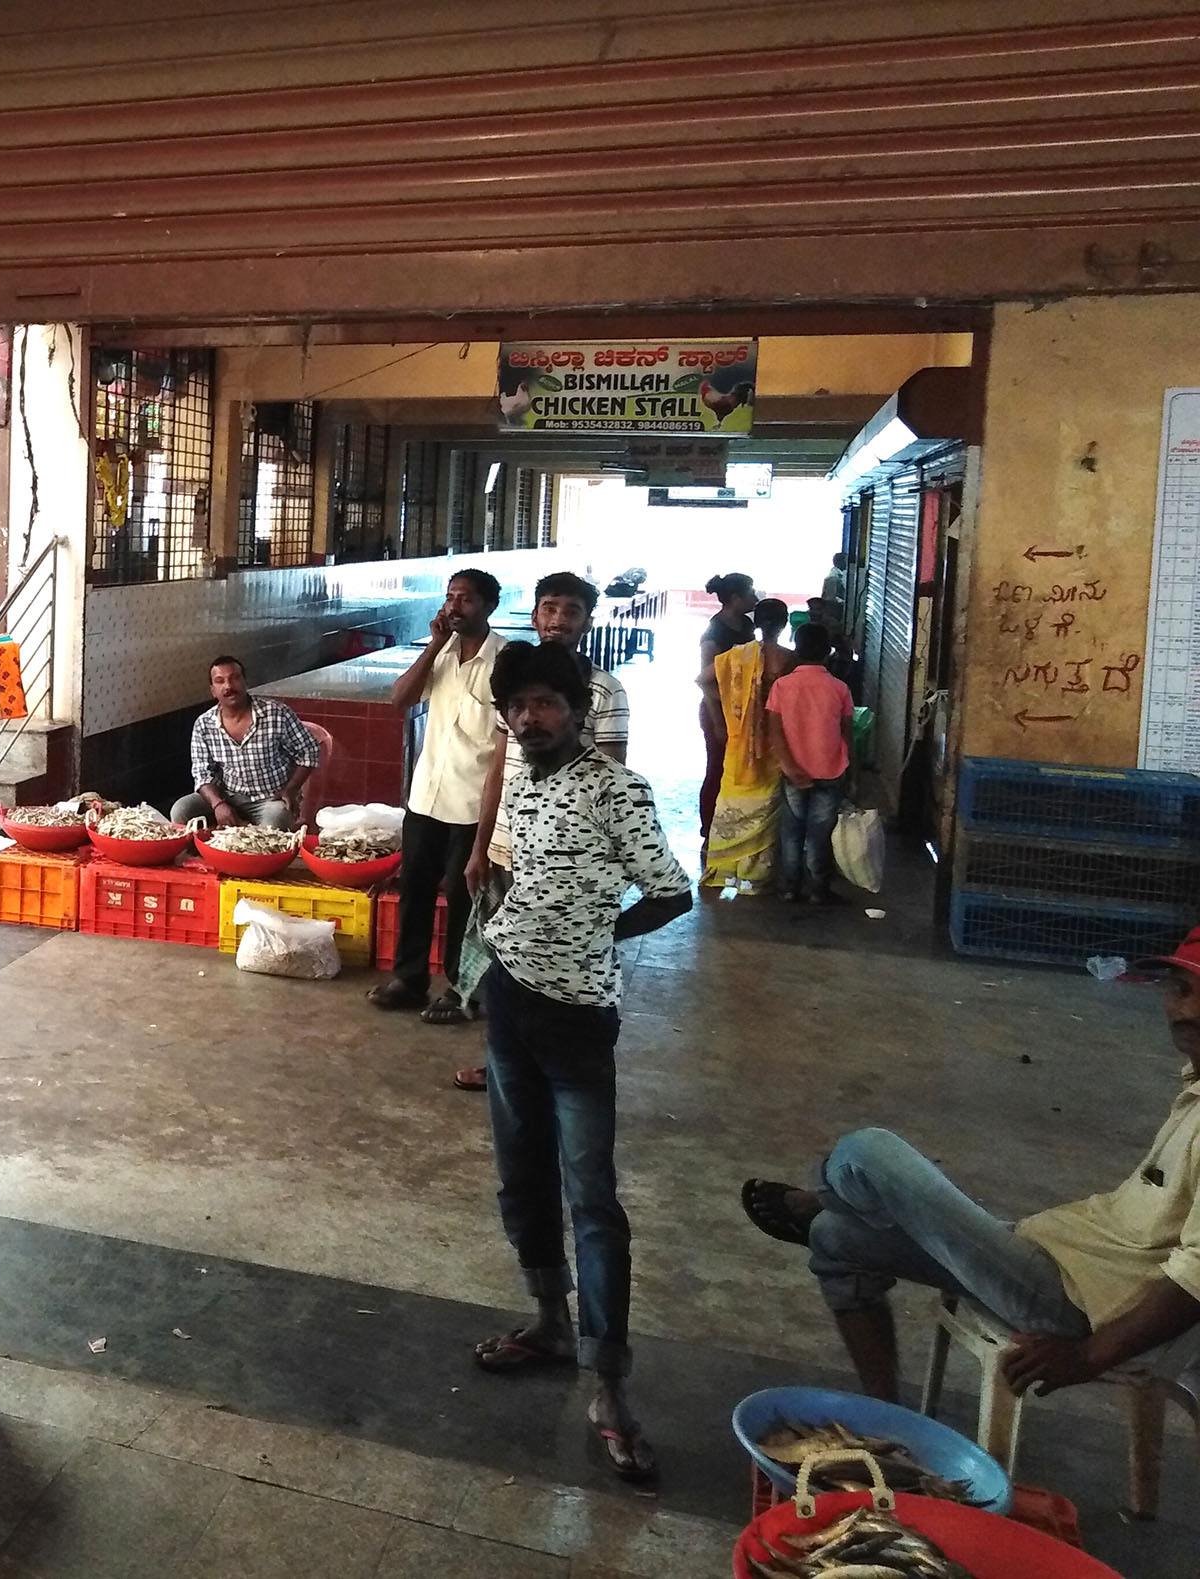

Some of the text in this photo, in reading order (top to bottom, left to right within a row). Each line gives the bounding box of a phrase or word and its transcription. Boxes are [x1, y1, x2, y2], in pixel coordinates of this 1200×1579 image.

[593, 347, 670, 368] ಚಿಕನ್
[563, 373, 670, 391] BISMILLAH
[530, 396, 702, 419] CHICKEN STALL
[544, 420, 569, 429] Mob:
[637, 421, 701, 431] 9844086519
